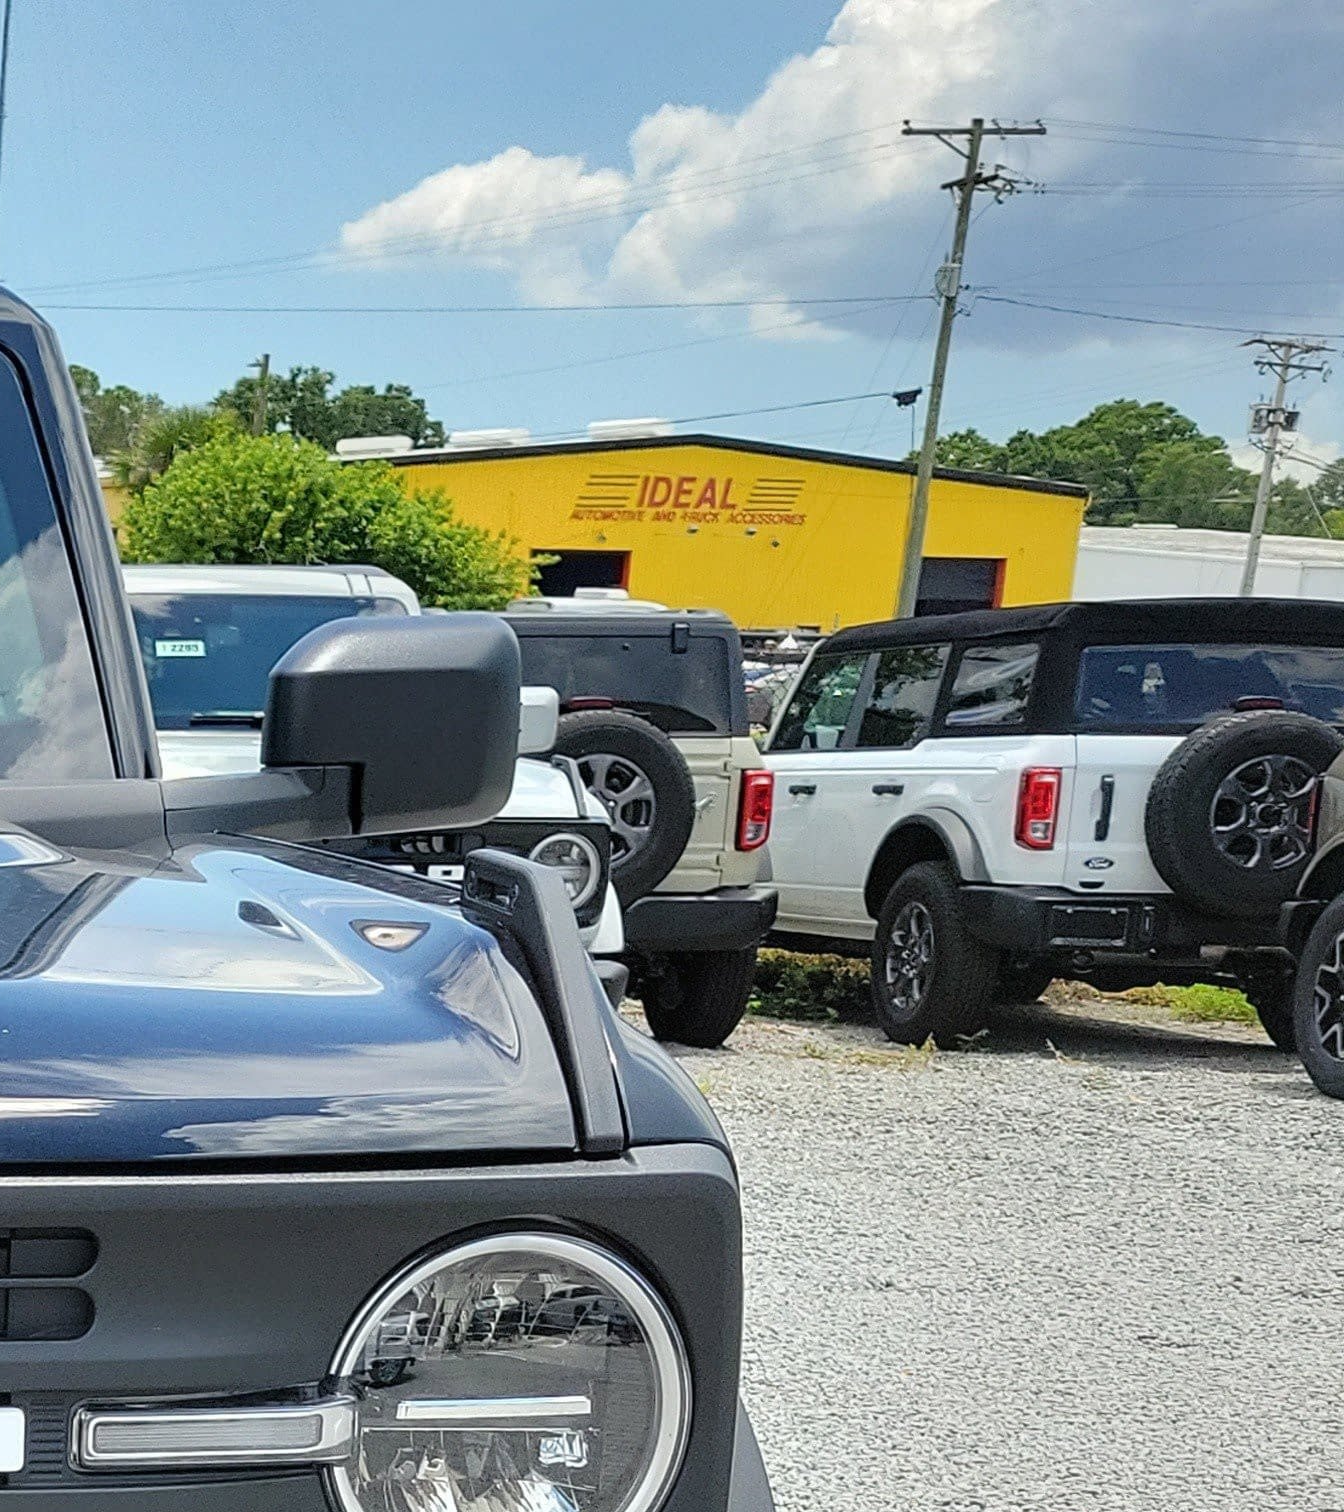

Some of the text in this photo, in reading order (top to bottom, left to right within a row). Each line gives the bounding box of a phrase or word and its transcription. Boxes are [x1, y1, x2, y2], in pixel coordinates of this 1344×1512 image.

[635, 475, 740, 510] IDEAL
[570, 509, 807, 526] AUTOMOTIVE AND TRUCK ACCESSORIES
